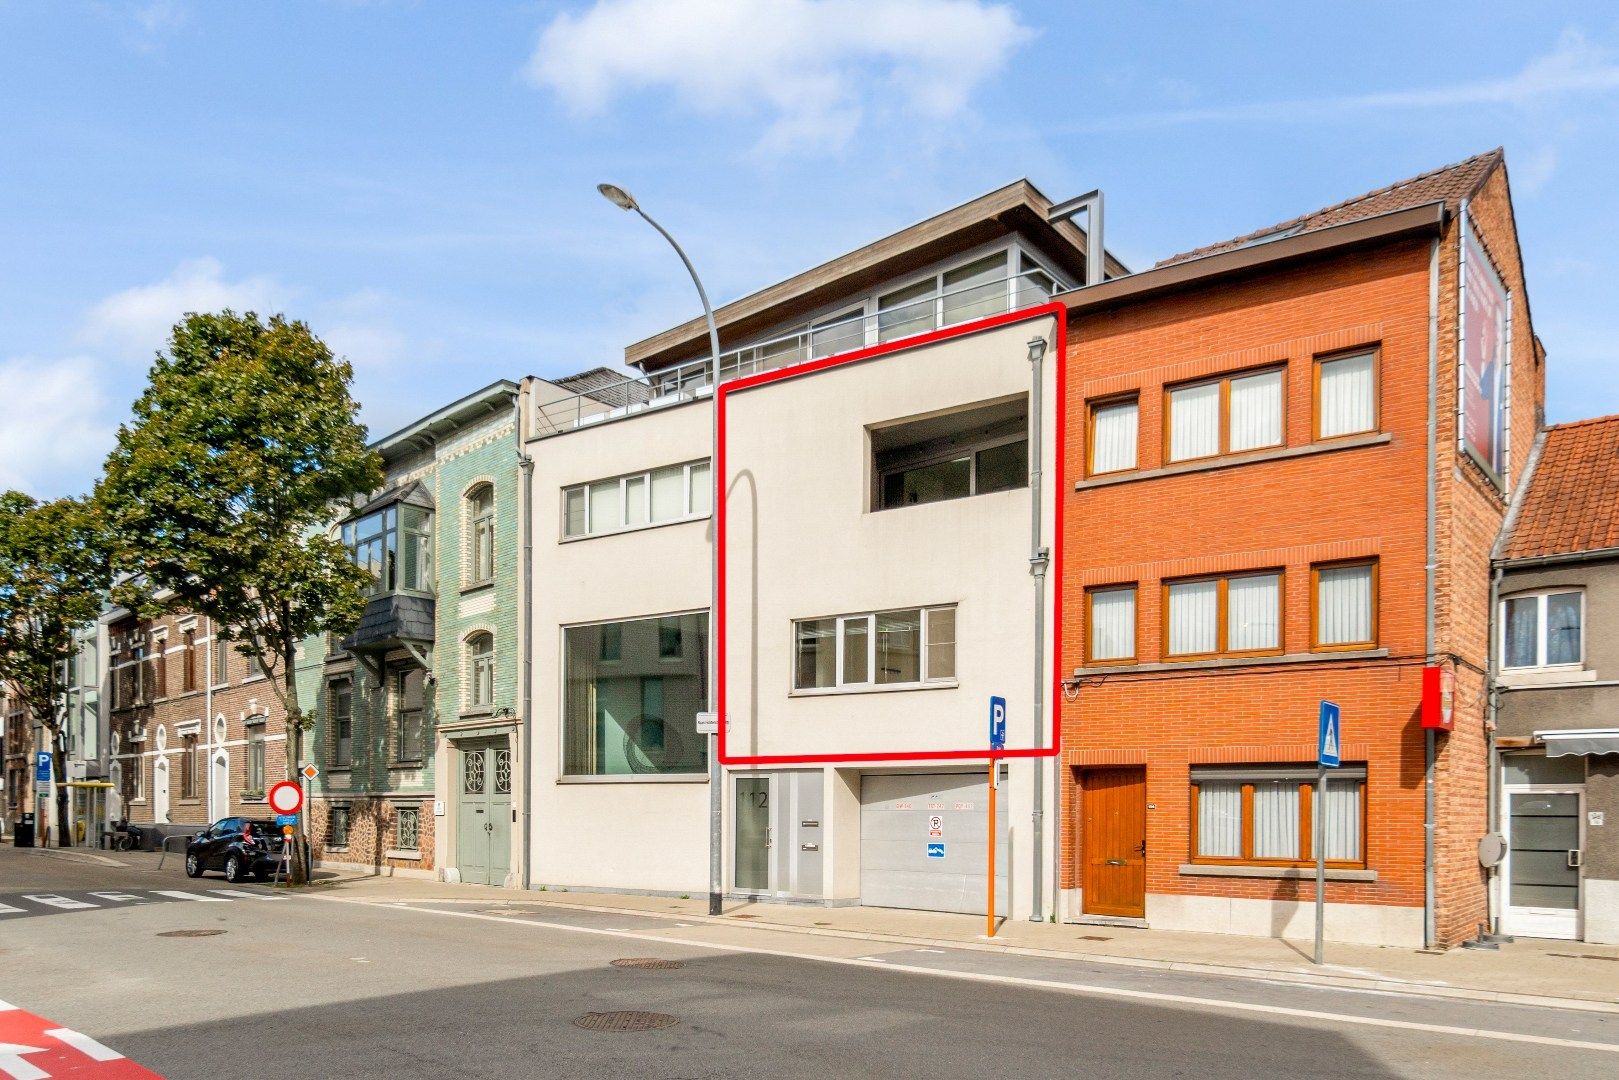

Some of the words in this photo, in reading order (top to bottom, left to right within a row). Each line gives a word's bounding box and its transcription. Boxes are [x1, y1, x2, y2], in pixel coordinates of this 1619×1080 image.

[993, 704, 1004, 735] P
[38, 754, 49, 766] P
[740, 791, 768, 808] 112
